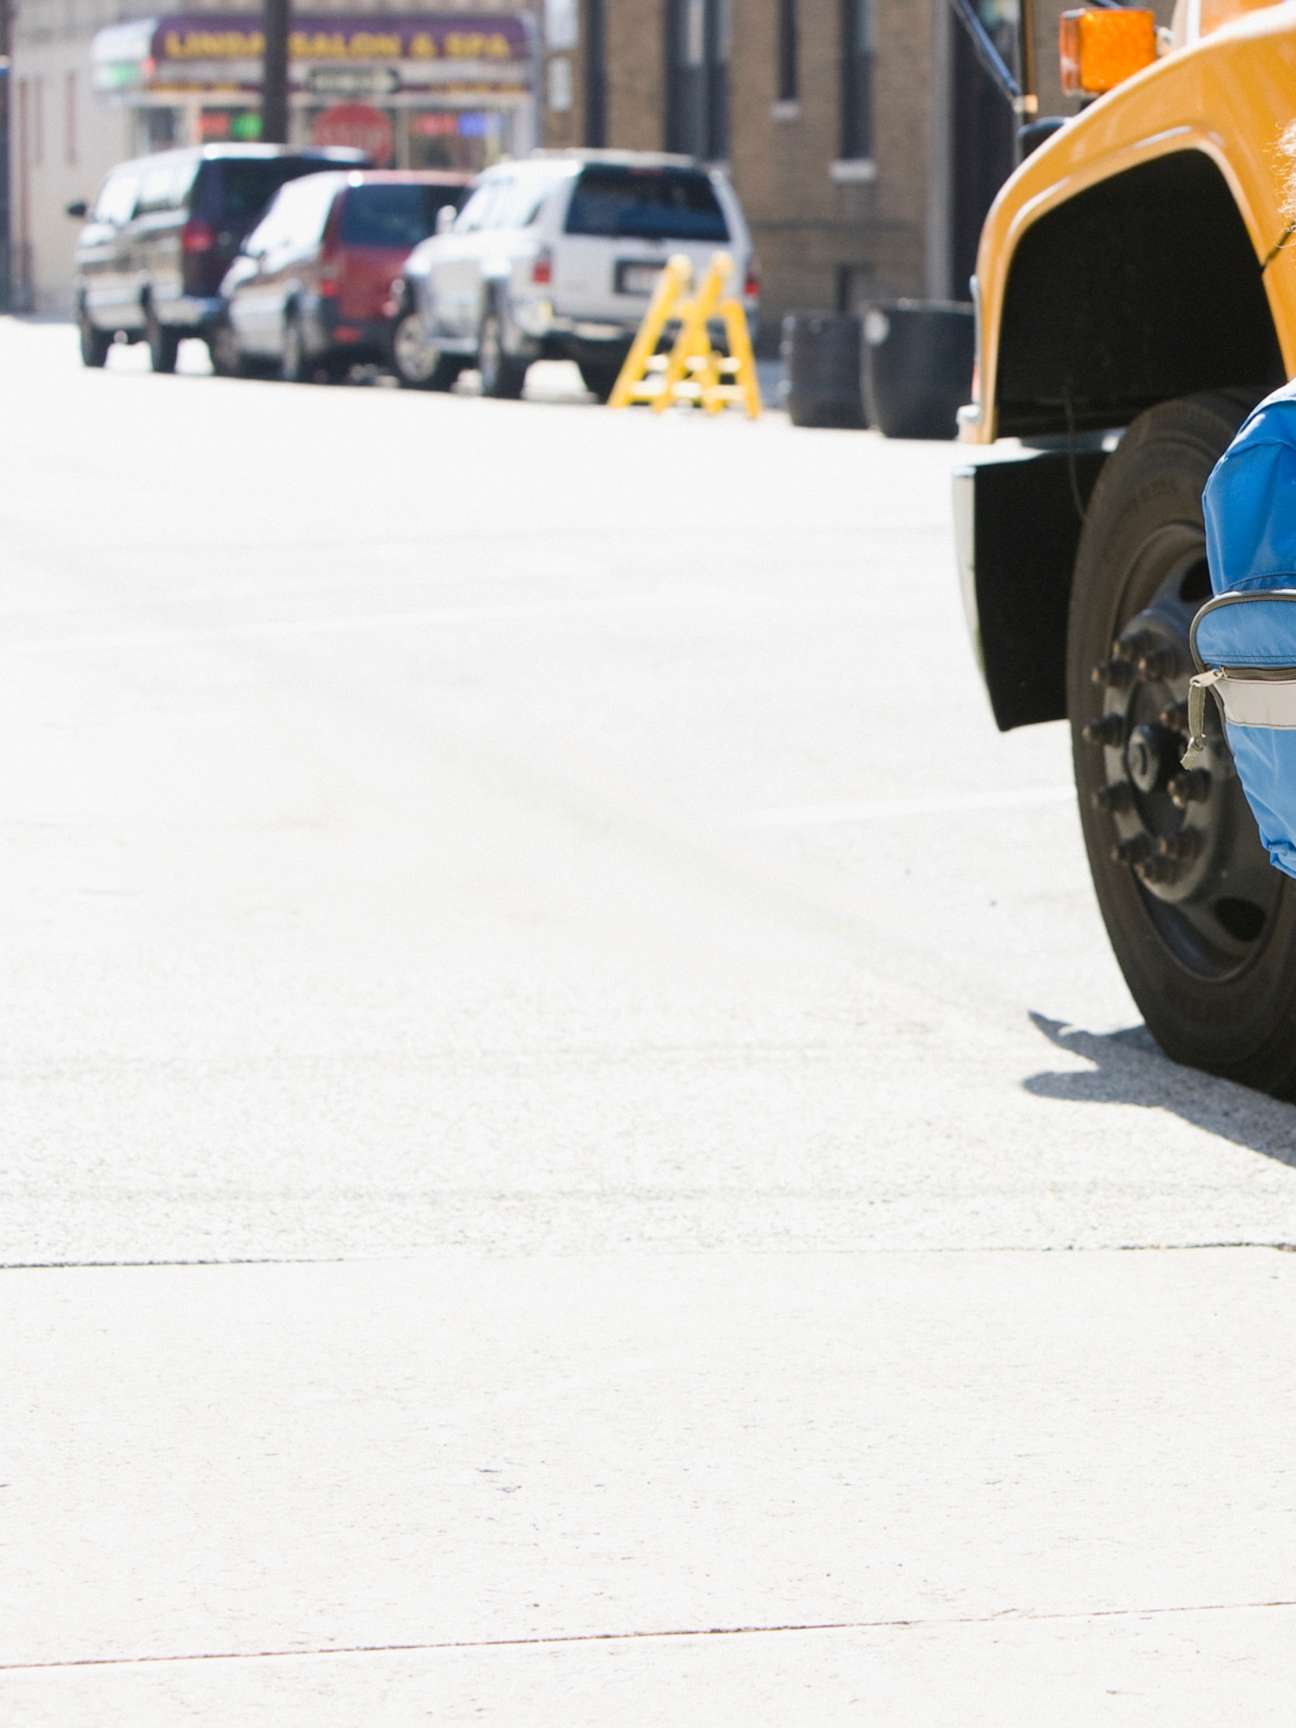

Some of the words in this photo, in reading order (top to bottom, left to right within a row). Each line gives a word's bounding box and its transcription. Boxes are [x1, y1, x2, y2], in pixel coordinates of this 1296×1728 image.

[288, 31, 402, 58] SALON
[410, 32, 436, 58] &
[445, 31, 511, 58] SPA
